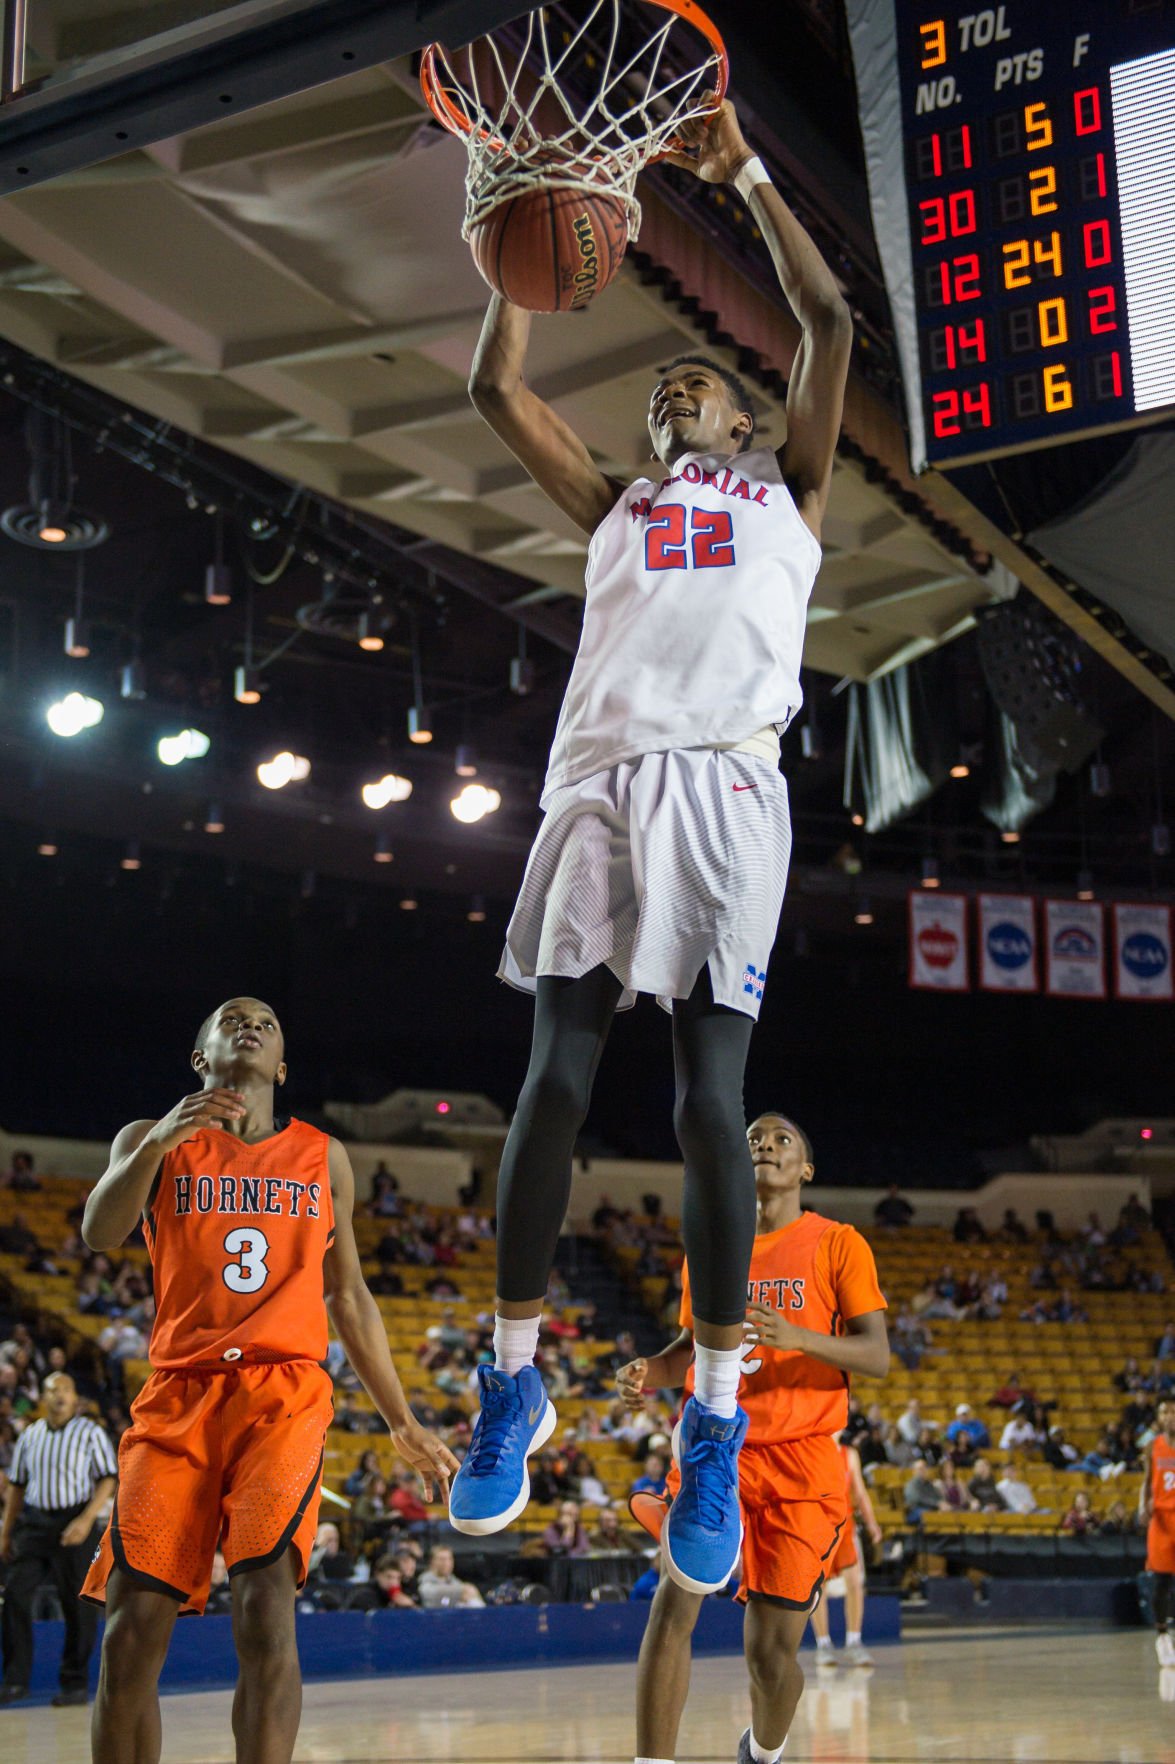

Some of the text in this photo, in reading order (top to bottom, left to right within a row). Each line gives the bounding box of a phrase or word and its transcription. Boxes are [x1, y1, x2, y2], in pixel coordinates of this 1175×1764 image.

[916, 34, 1090, 115] NO. PTS F
[920, 5, 1012, 70] 3 TOL
[932, 87, 1101, 177] 11 5 0
[919, 152, 1107, 245] 30 2 1
[940, 219, 1112, 305] 12 24 0
[944, 285, 1117, 370] 14 0 2
[932, 351, 1122, 438] 24 6 1
[630, 462, 769, 523] MORIAL
[645, 503, 736, 571] 22
[174, 1175, 321, 1218] HORNETS
[222, 1227, 271, 1295] 3
